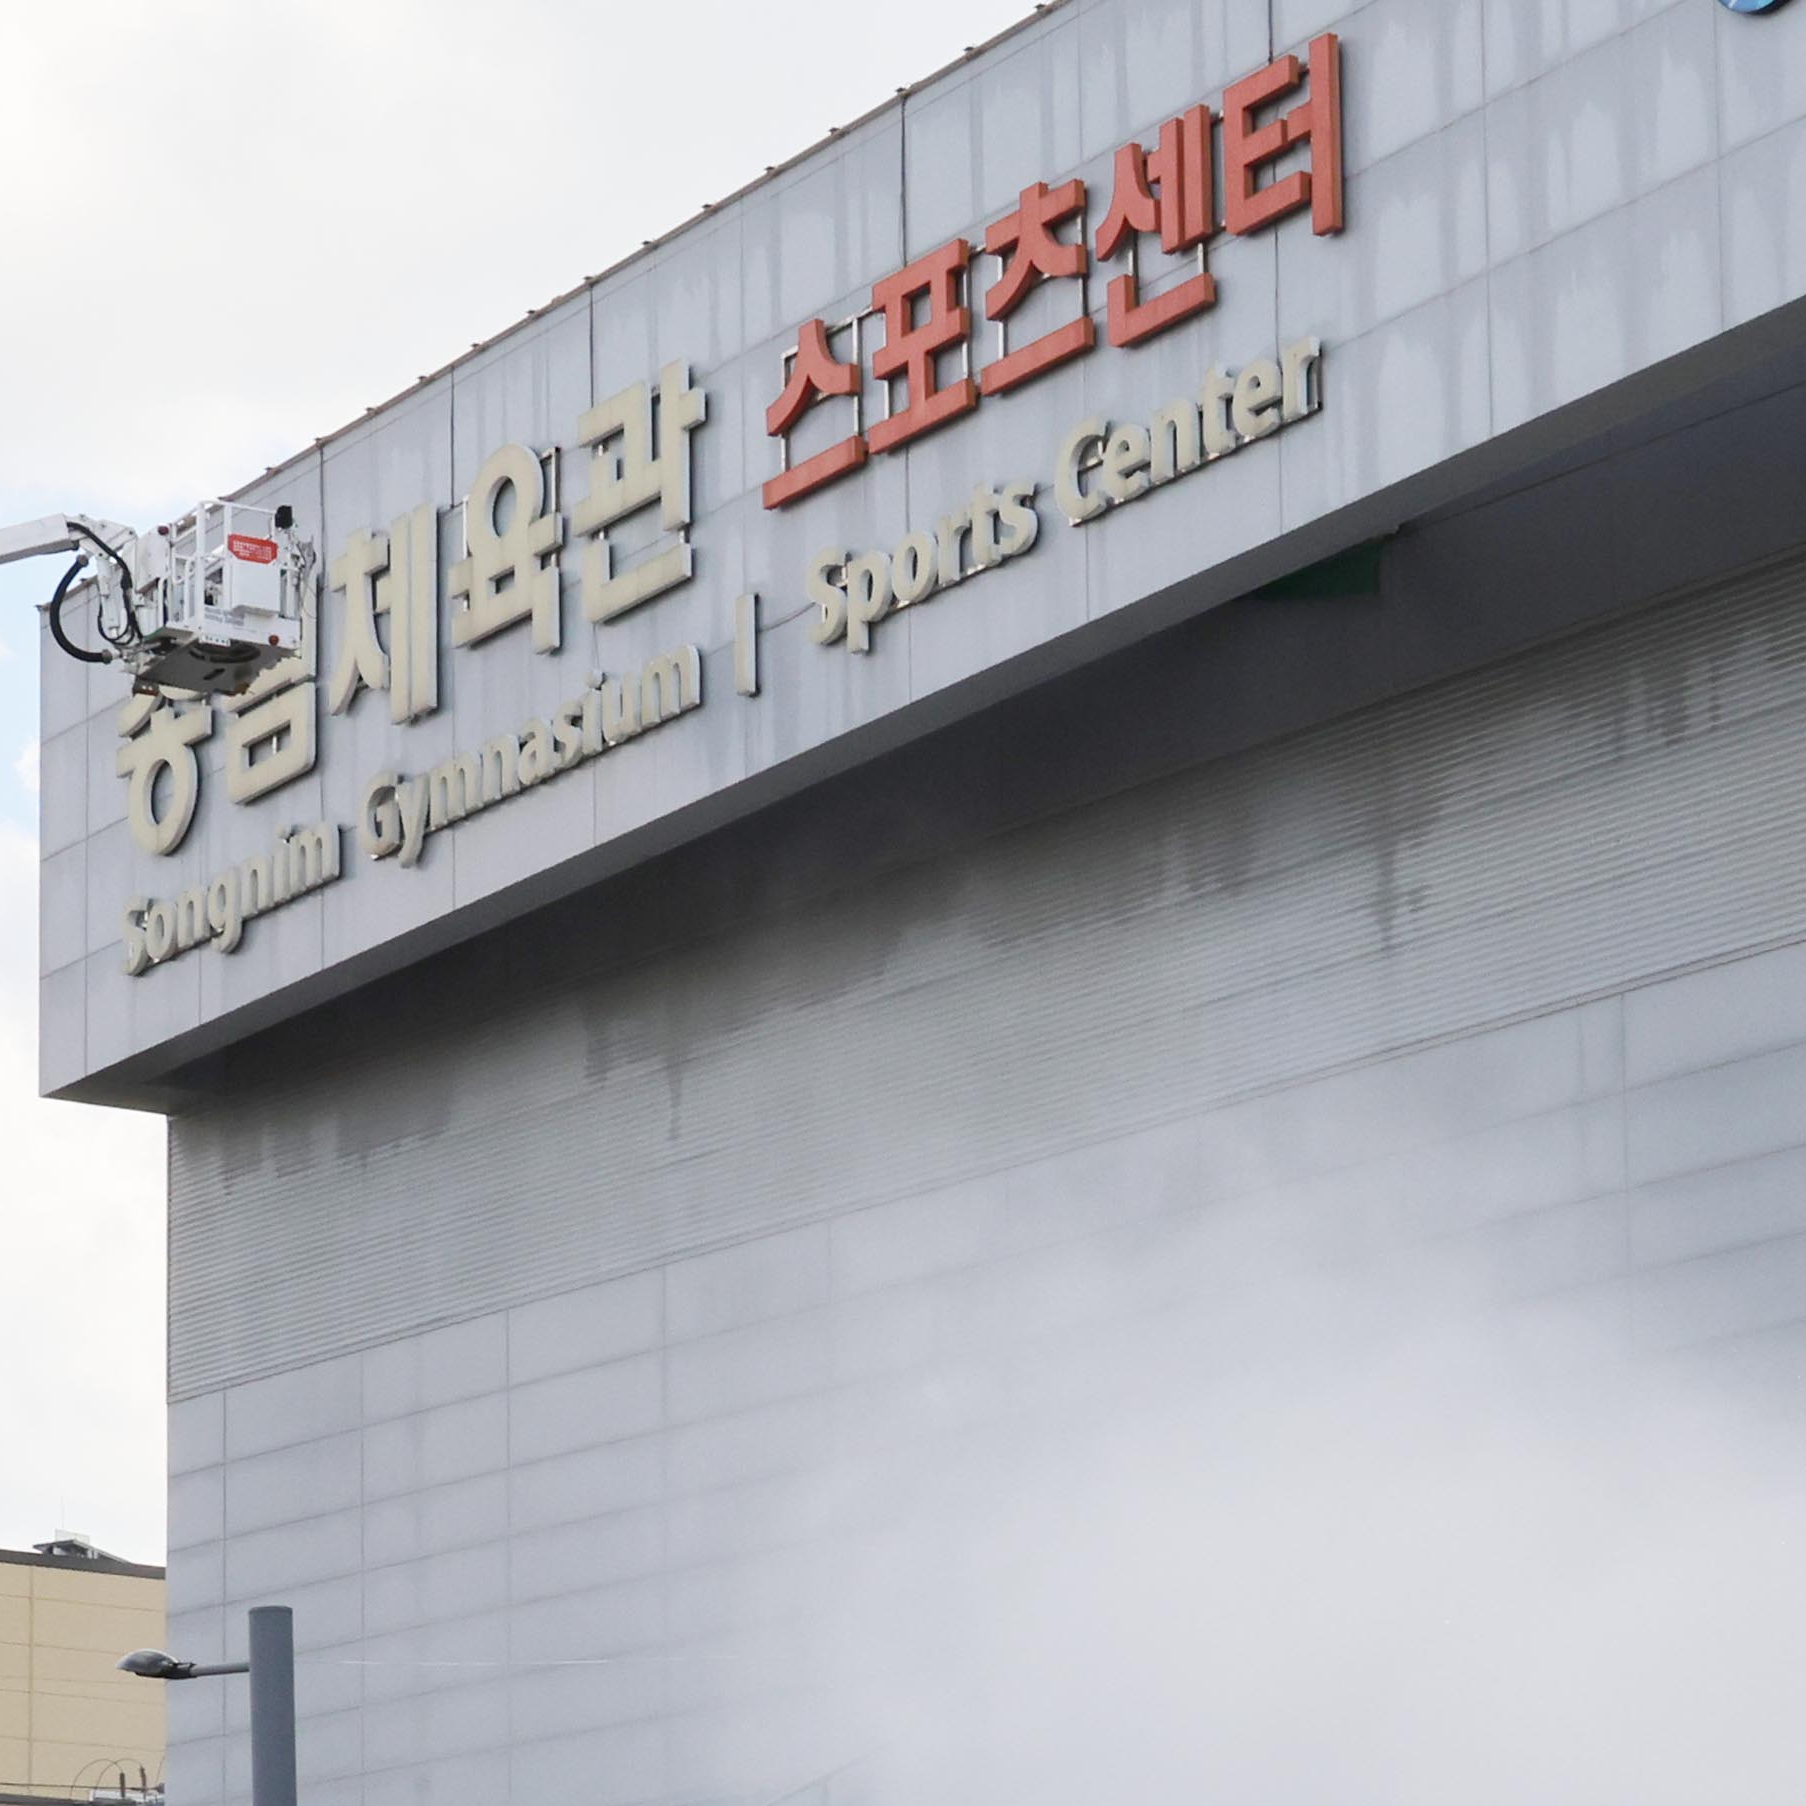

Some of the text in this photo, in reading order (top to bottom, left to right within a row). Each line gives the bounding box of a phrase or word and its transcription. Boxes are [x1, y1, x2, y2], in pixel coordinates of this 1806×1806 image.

[762, 32, 1345, 511] 스포츠센터
[120, 335, 1323, 977] Songnim Gymnasium Sports Center
